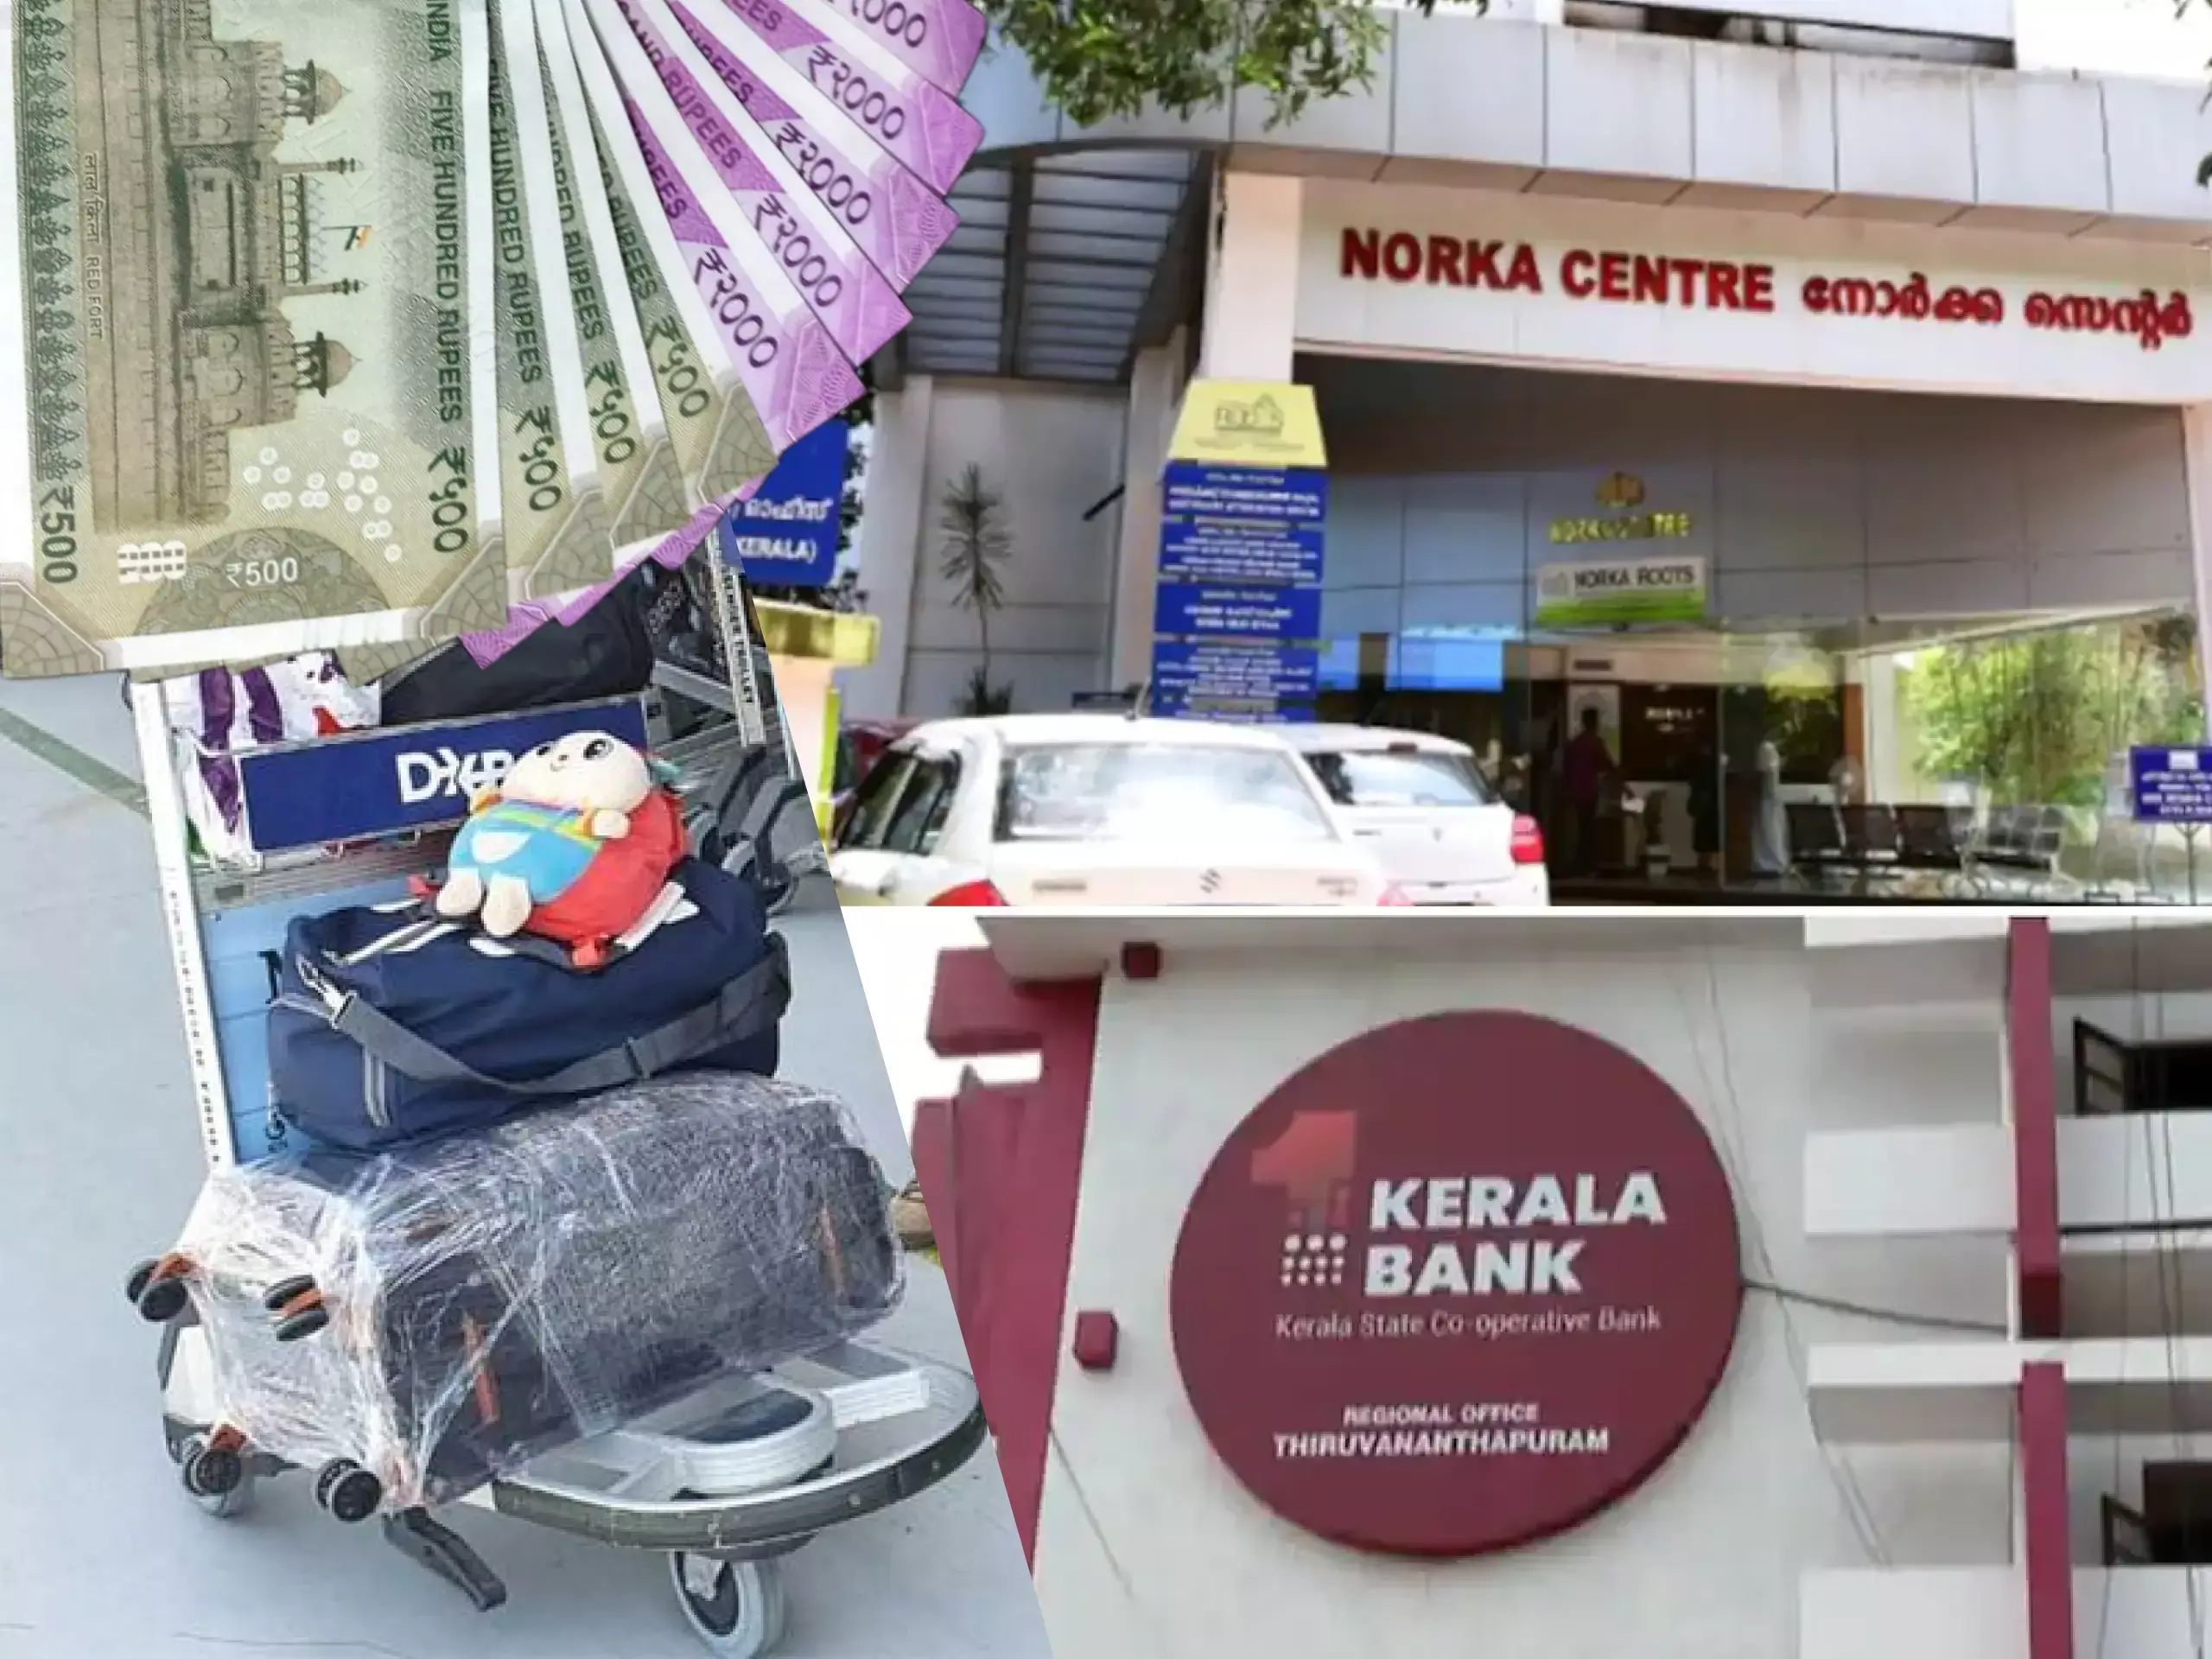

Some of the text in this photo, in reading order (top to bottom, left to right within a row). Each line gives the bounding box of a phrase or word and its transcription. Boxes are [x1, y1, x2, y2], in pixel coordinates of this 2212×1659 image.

[426, 0, 452, 61] NDIA
[430, 89, 455, 151] FIVE
[665, 69, 742, 169] RUPEES
[433, 162, 459, 300] HUNDRED
[490, 128, 524, 264] HUNDRED
[86, 257, 104, 340] RED FORT
[563, 230, 604, 340] RUPEES
[1340, 227, 1544, 294] NORKA
[1559, 249, 1776, 312] CENTRE
[506, 271, 543, 383] RUPEES
[436, 309, 463, 423] RUPEES
[40, 485, 79, 584] ₹500
[226, 556, 299, 589] ₹500
[1574, 564, 1694, 588] NORKA ROOTS
[1368, 1171, 1668, 1230] KERALA
[1363, 1238, 1587, 1297] BANK
[1274, 1304, 1662, 1342] Kerala State Co-operative Bank
[1272, 1427, 1610, 1459] THIRUVANANTHAPURAM
[1342, 1401, 1541, 1428] REGIONAL OFFICE
